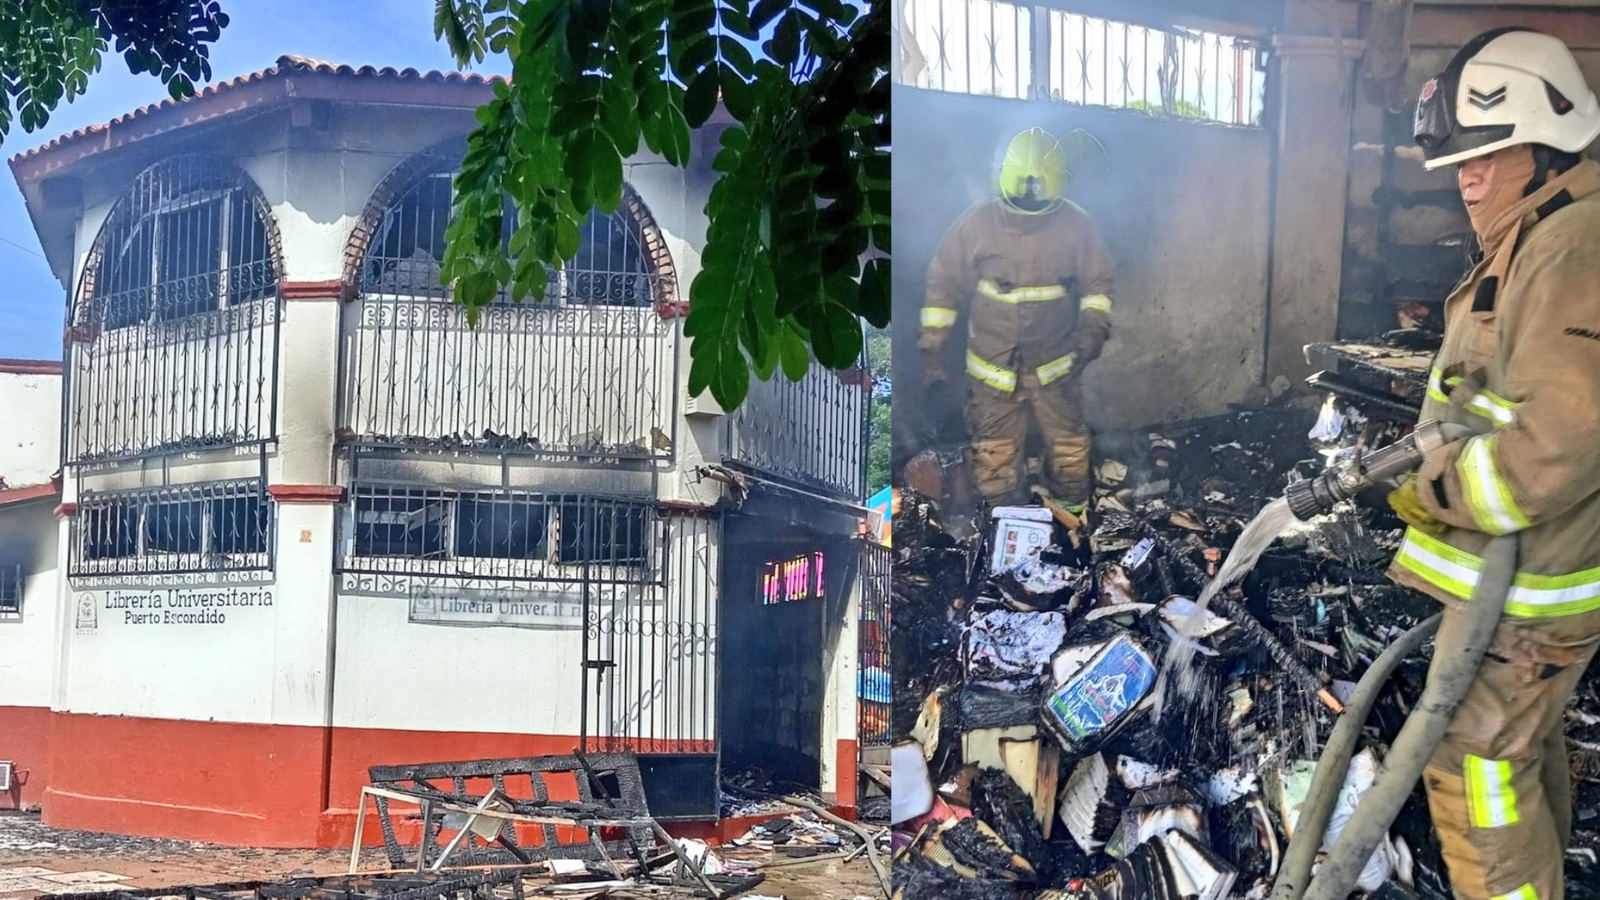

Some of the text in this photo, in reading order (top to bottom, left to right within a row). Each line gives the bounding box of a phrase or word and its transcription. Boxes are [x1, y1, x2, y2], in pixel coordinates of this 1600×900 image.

[105, 586, 273, 609] Librería Universitaria
[440, 596, 493, 614] Librería
[124, 608, 226, 625] Puerto Escondido
